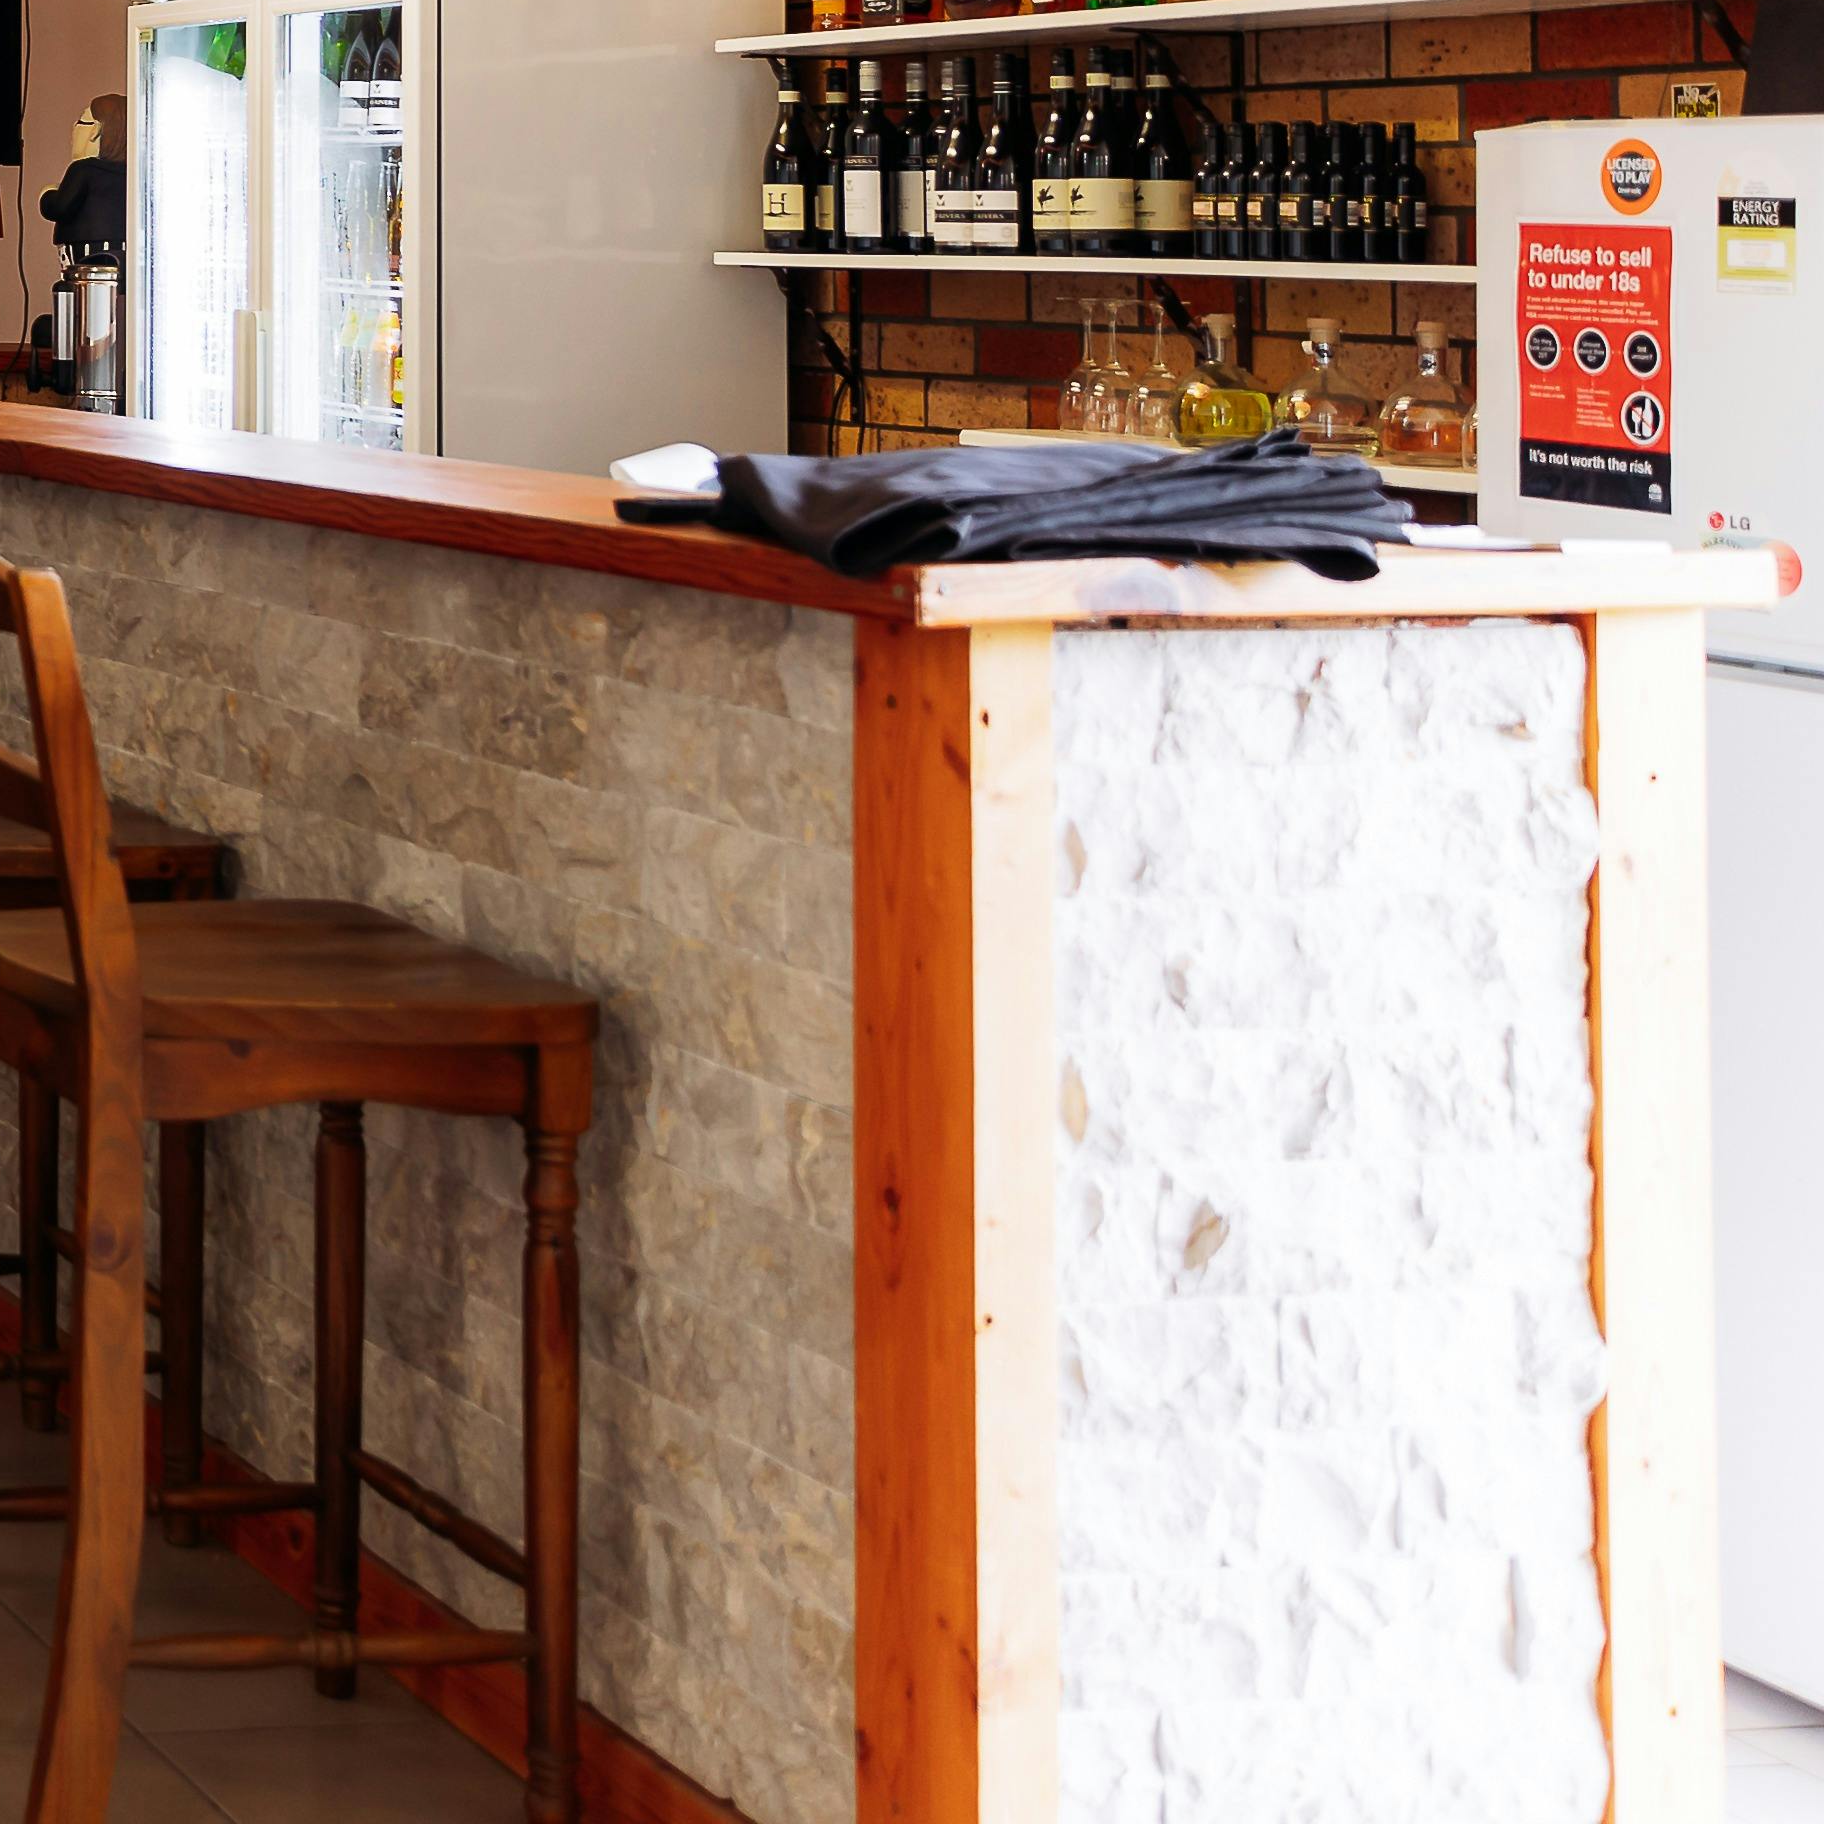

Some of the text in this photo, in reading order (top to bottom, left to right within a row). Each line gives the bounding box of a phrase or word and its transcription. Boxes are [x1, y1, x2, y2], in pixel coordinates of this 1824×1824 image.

[1606, 157, 1656, 171] LICENSED
[1611, 171, 1652, 184] TO PLAY
[1732, 200, 1780, 213] ENERGY
[1733, 213, 1779, 226] RATING
[1529, 242, 1652, 268] Refuse to sell
[1528, 268, 1641, 292] to under 18s
[1529, 448, 1652, 475] It's not worth the risk
[1729, 515, 1750, 530] LG
